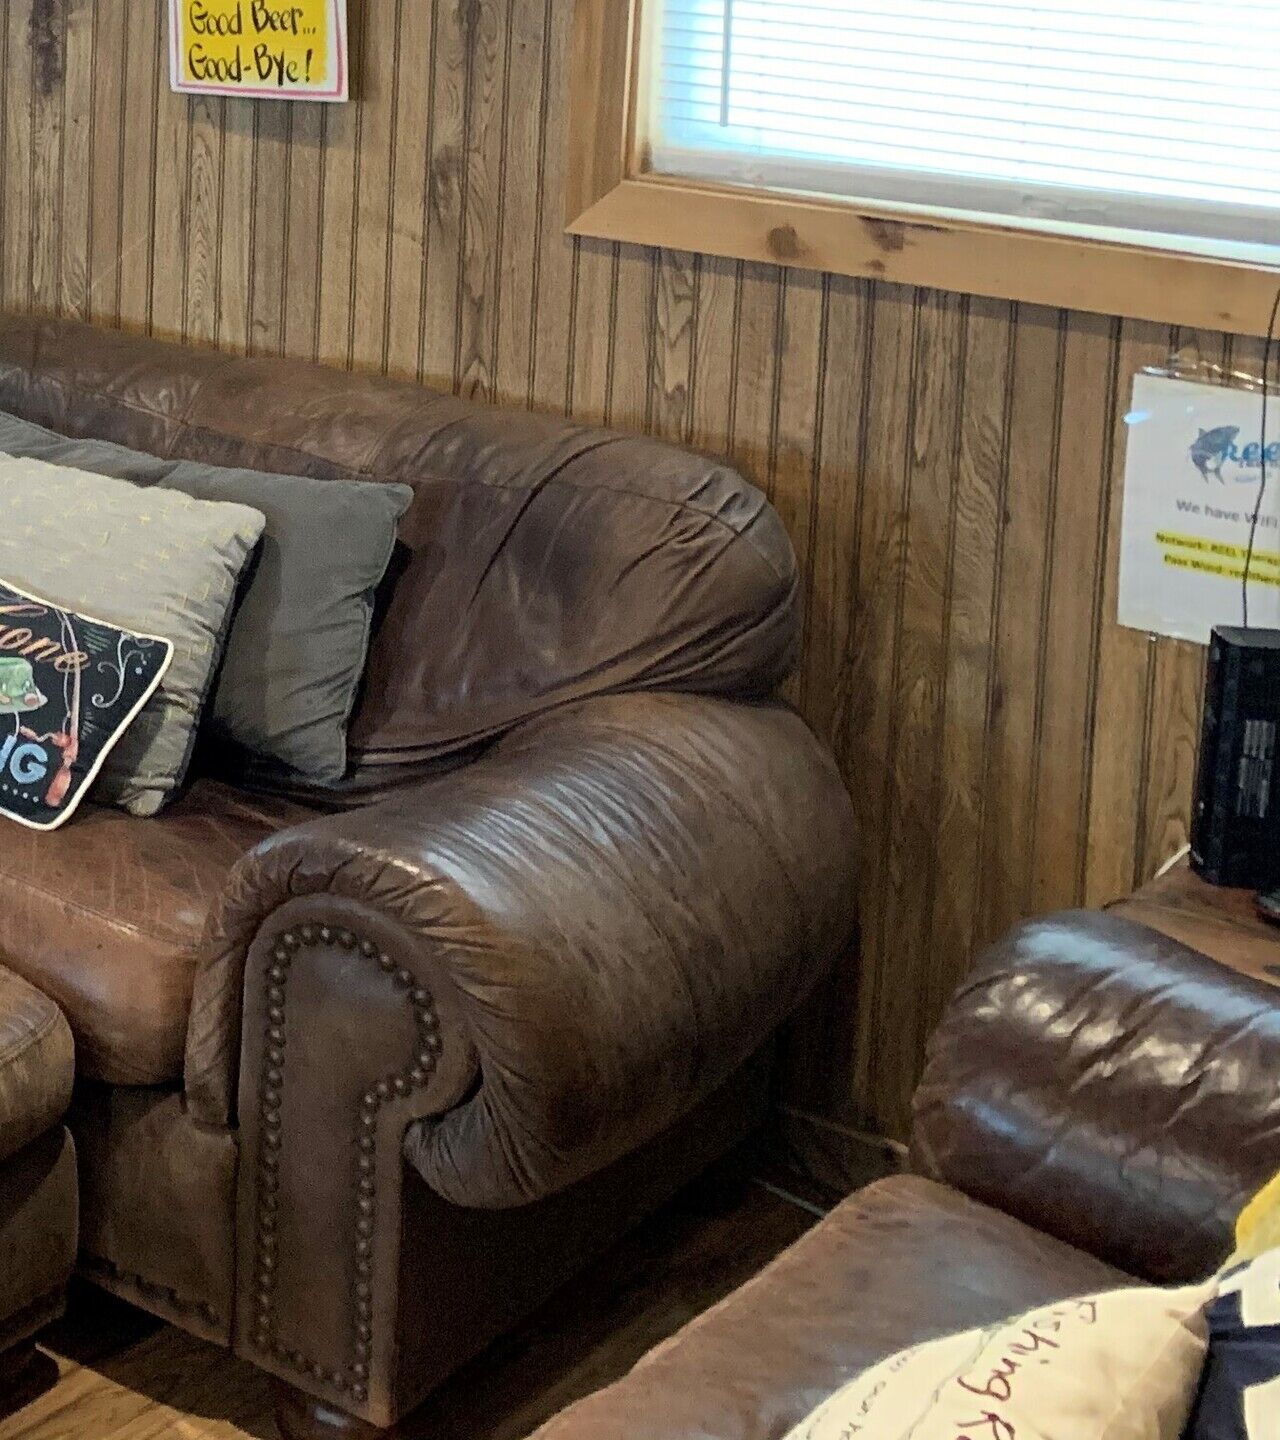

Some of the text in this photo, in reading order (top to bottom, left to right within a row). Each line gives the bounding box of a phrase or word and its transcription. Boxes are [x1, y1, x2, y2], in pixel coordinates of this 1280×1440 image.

[188, 0, 243, 36] Good
[1176, 498, 1201, 514] We
[1204, 504, 1240, 522] have
